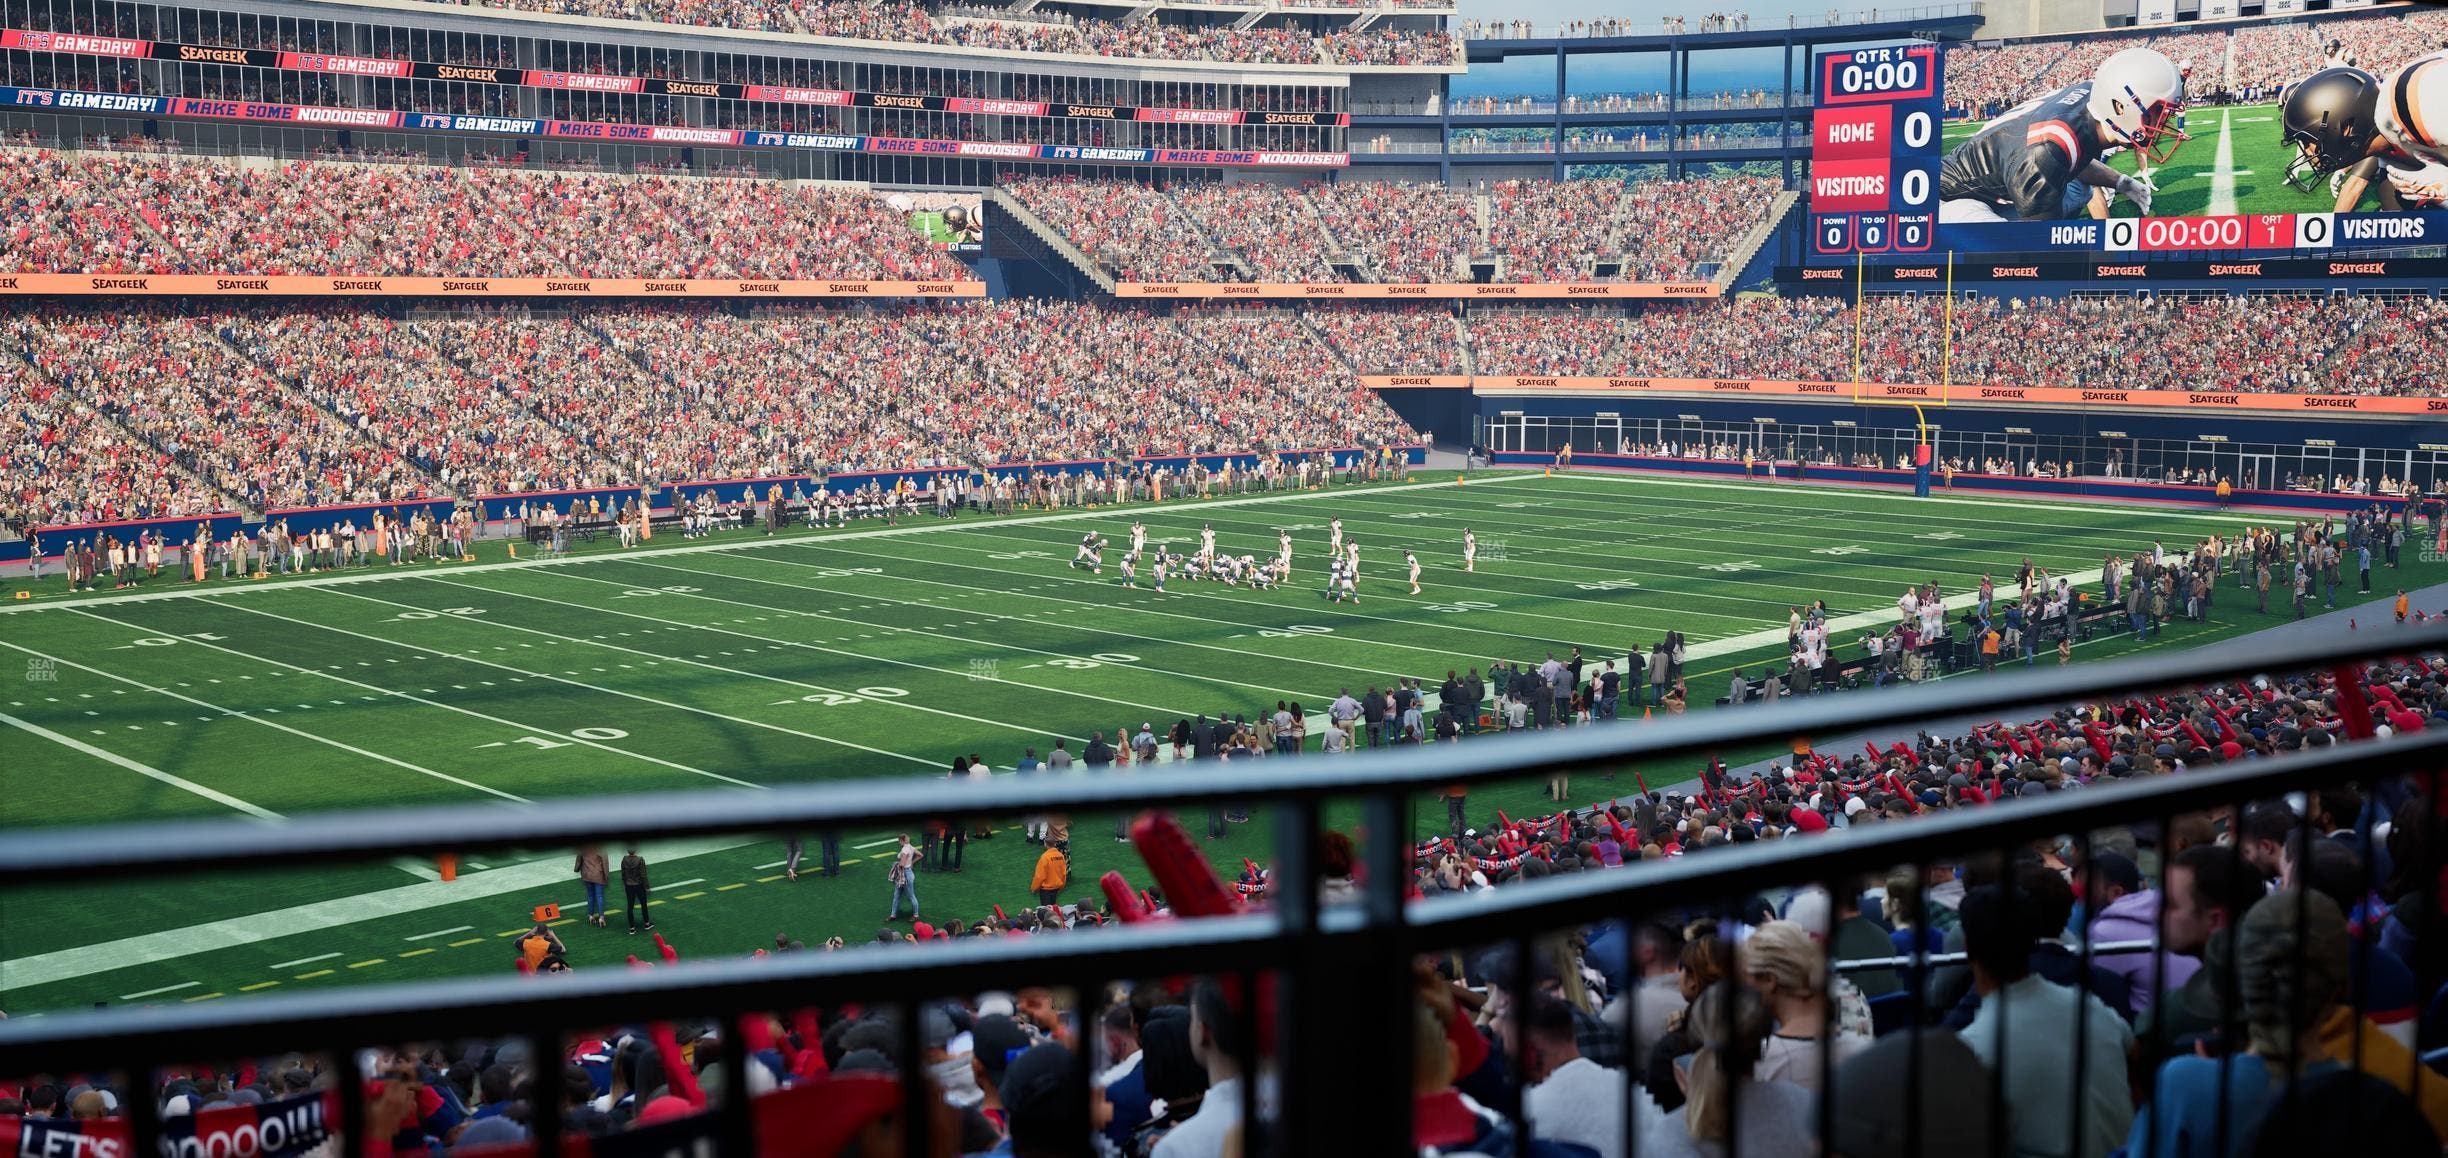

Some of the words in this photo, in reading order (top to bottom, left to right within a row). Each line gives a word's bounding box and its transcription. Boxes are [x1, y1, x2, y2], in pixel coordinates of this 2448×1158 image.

[21, 34, 48, 47] IT'S
[54, 36, 136, 55] GAMEDAY!
[180, 46, 248, 64] SEATGEEK
[1856, 49, 1890, 63] QTR
[1896, 48, 1903, 60] 1
[299, 57, 323, 68] IT'S
[328, 55, 399, 74] GAMEDAY!
[438, 64, 497, 82] SEATGEEK
[1843, 61, 1916, 92] 0:00
[543, 75, 563, 85] IT'S
[567, 75, 632, 91] GAMEDAY!
[667, 81, 720, 97] SEATGEEK
[17, 89, 53, 105] IT'S
[59, 93, 157, 112] GAMEDAY!
[760, 88, 781, 100] IT'S
[785, 90, 843, 104] GAMEDAY!
[874, 95, 924, 108] SEATGEEK
[185, 101, 238, 116] MAKE
[246, 105, 293, 119] SOME
[960, 100, 979, 112] IT'S
[983, 102, 1037, 115] GAMEDAY!
[1068, 106, 1115, 119] SEATGEEK
[1151, 108, 1171, 120] IT'S
[1175, 111, 1234, 123] GAMEDAY!
[1266, 114, 1315, 124] SEATGEEK
[421, 115, 451, 128] IT'S
[455, 118, 536, 133] GAMEDAY!
[559, 124, 603, 136] MAKE
[610, 126, 649, 138] SOME
[1905, 112, 1931, 147] 0
[1830, 123, 1874, 143] HOME
[758, 134, 784, 145] IT'S
[787, 135, 857, 149] GAMEDAY!
[878, 140, 916, 150] MAKE
[922, 142, 956, 152] SOME
[1054, 146, 1078, 158] IT'S
[1081, 148, 1146, 161] GAMEDAY!
[1167, 151, 1211, 163] MAKE
[1215, 153, 1254, 162] SOME
[1817, 176, 1884, 196] VISITORS
[1903, 170, 1929, 204] 0
[2262, 215, 2282, 225] QRT
[1906, 226, 1919, 243] 0
[2052, 226, 2096, 244] HOME
[2113, 222, 2131, 246] 0
[2146, 219, 2241, 246] 00:00
[2267, 226, 2275, 243] 1
[2304, 217, 2326, 242] 0
[2343, 218, 2424, 238] VISITORS
[1828, 228, 1840, 244] 0
[1867, 227, 1879, 244] 0
[1803, 269, 1842, 279] SEATGEEK
[1895, 268, 1937, 278] SEATGEEK
[1993, 267, 2038, 277] SEATGEEK
[2098, 266, 2145, 276] SEATGEEK
[2209, 264, 2261, 275] SEATGEEK
[2329, 263, 2385, 274] SEATGEEK
[93, 279, 148, 289] SEATGEEK
[217, 280, 268, 290] SEATGEEK
[333, 281, 382, 290] SEATGEEK
[443, 282, 488, 291] SEATGEEK
[547, 282, 590, 291] SEATGEEK
[645, 283, 686, 292] SEATGEEK
[740, 284, 779, 292] SEATGEEK
[830, 284, 868, 292] SEATGEEK
[917, 285, 953, 293] SEATGEEK
[1715, 382, 1749, 390] SEATGEEK
[1798, 384, 1835, 392] SEATGEEK
[1887, 386, 1927, 395] SEATGEEK
[1982, 389, 2024, 398] SEATGEEK
[2082, 392, 2128, 401] SEATGEEK
[2190, 395, 2238, 404] SEATGEEK
[2304, 398, 2356, 408] SEATGEEK
[1257, 625, 1334, 638] 40
[1046, 653, 1141, 669] 30
[802, 687, 910, 706] 20
[545, 907, 552, 917] G
